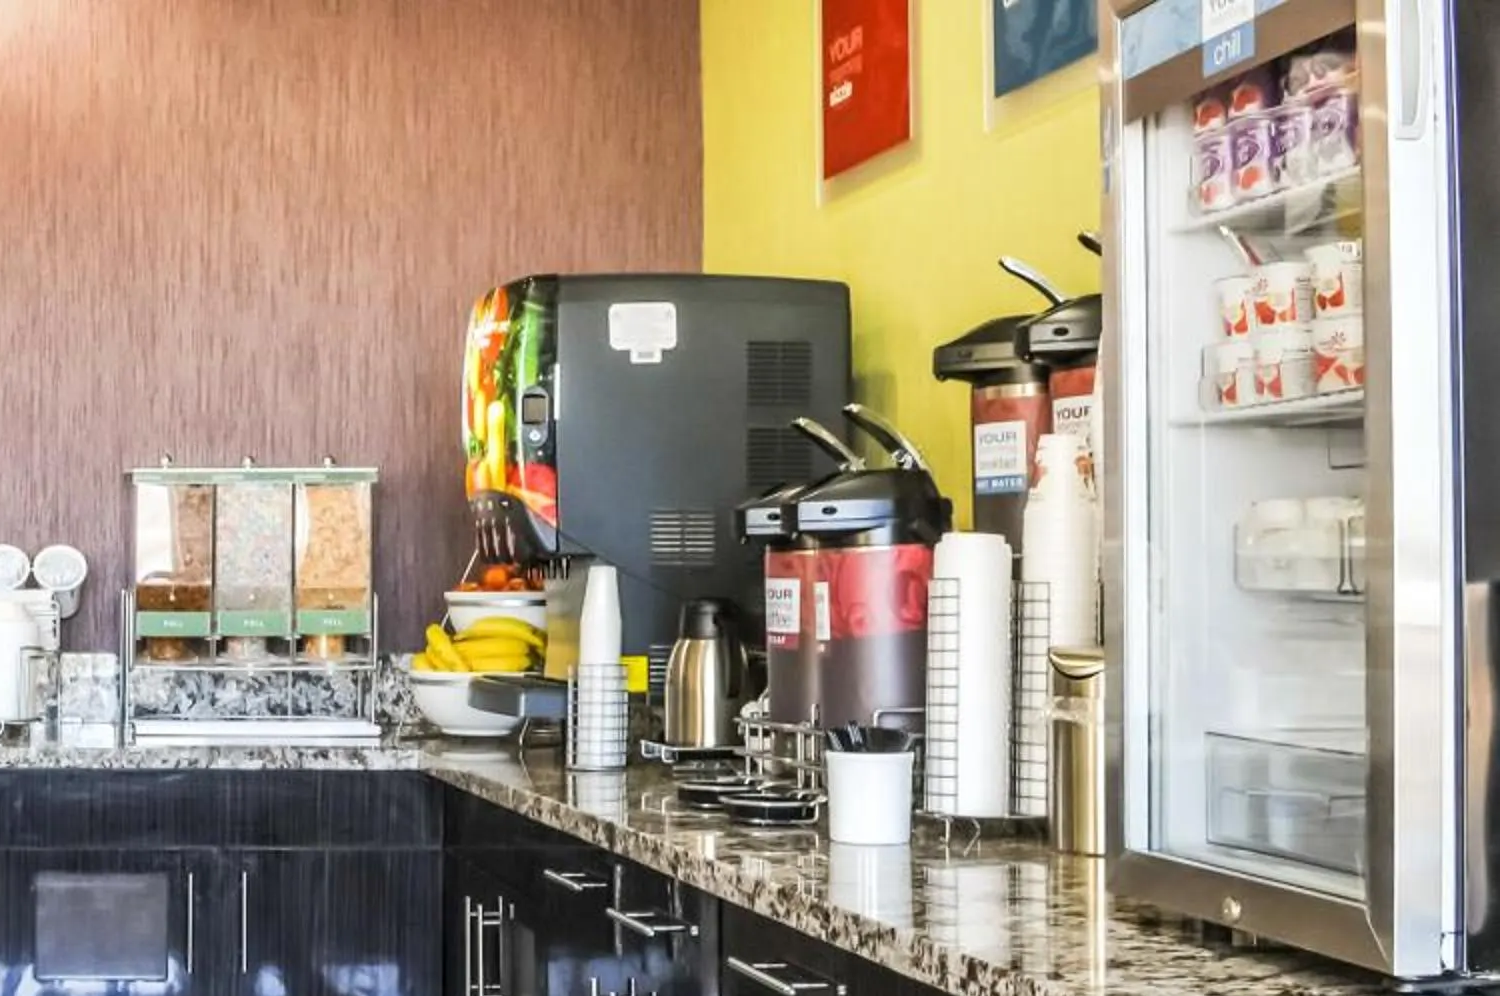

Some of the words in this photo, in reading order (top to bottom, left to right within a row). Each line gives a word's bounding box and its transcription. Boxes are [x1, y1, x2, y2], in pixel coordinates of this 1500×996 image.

[829, 25, 863, 63] YOUR
[1214, 29, 1241, 65] chill
[979, 431, 1017, 446] YOUR
[767, 588, 792, 600] OUR
